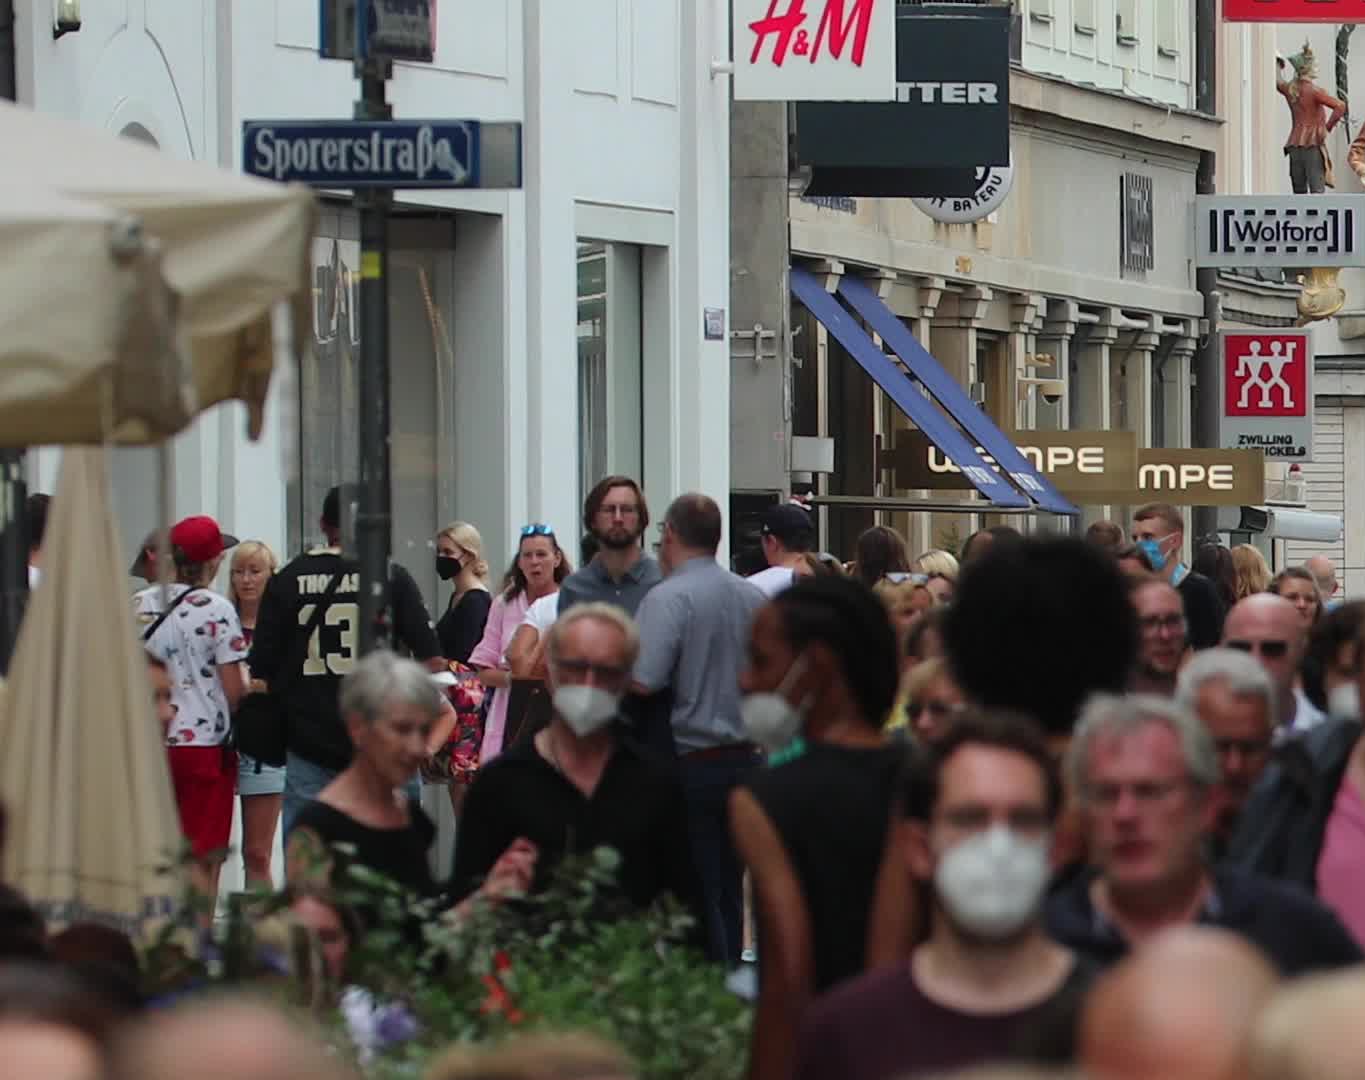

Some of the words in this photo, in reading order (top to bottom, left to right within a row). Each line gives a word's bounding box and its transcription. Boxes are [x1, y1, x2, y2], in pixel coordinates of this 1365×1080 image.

[748, 0, 875, 67] H&M
[896, 82, 998, 103] TTER
[254, 126, 465, 180] Sporerstraße
[953, 175, 1002, 211] BATEAU
[1234, 220, 1328, 242] Wolford
[1238, 434, 1293, 445] ZWILLING
[1139, 464, 1233, 490] MPE
[297, 573, 360, 594] THOAS
[298, 603, 359, 675] 13
